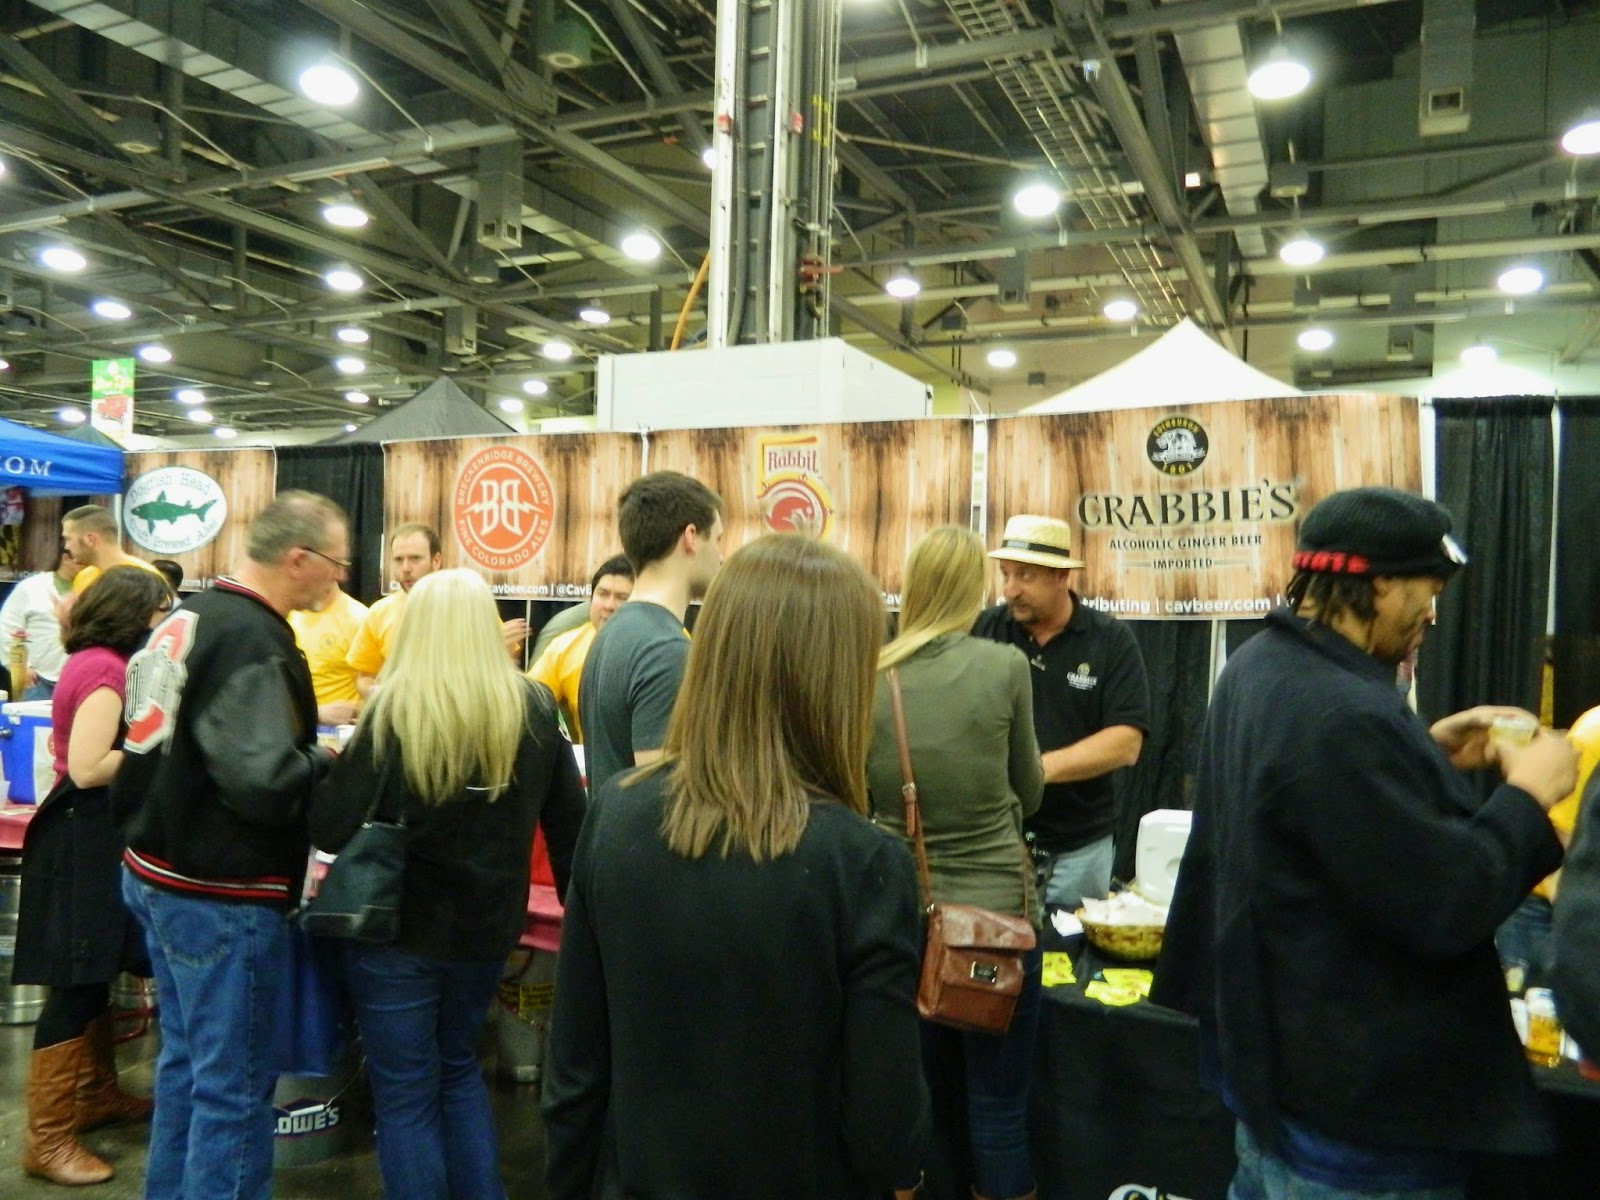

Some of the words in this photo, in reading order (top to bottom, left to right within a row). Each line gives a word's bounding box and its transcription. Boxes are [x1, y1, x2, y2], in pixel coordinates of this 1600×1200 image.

[0, 456, 52, 476] OM
[768, 450, 819, 472] Rabbit
[129, 472, 172, 503] Dogfish
[180, 471, 211, 496] Head
[458, 450, 513, 505] BRECKENRIDGE
[516, 455, 550, 506] BREWERY
[1078, 478, 1294, 533] CRABBIE'S
[458, 519, 473, 546] FINE
[472, 546, 529, 567] COLORADO
[531, 518, 549, 550] ALES
[1110, 539, 1174, 551] ALCOHOLIC
[1178, 537, 1227, 549] GINGER
[1231, 535, 1262, 547] BEER
[1153, 558, 1213, 570] IMPORTED
[1080, 597, 1151, 614] tributing
[1164, 597, 1271, 613] cavbeer.com
[274, 1107, 340, 1134] OWE'S
